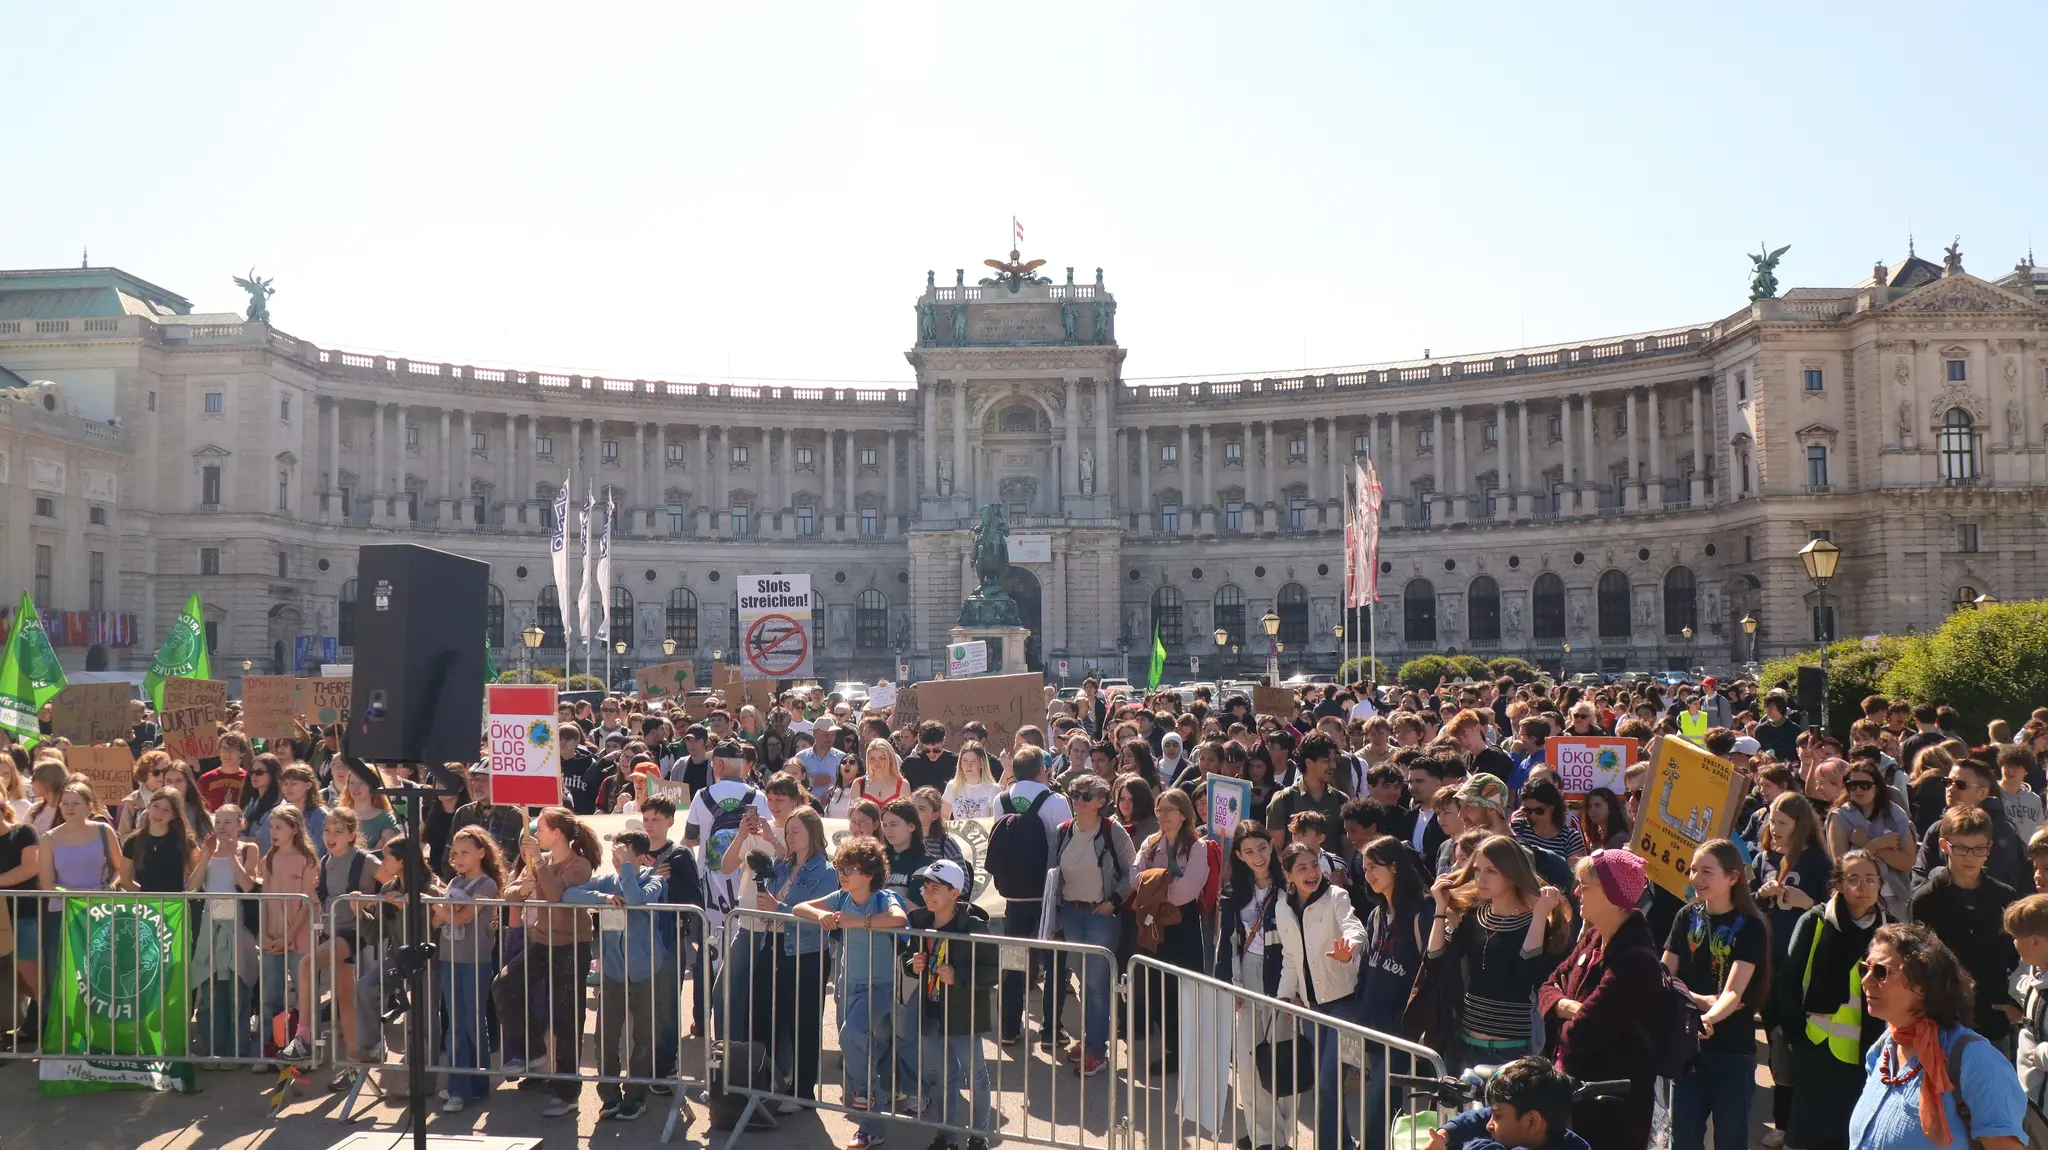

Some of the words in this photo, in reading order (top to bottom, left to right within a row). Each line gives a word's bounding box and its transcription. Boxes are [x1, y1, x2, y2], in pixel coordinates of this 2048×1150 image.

[758, 580, 791, 593] Slots
[741, 594, 808, 608] streichen!
[313, 681, 351, 695] THERE
[168, 692, 185, 704] DIE
[314, 695, 326, 707] IS
[330, 696, 349, 709] NO
[943, 704, 955, 717] A
[960, 704, 1001, 716] BETTER
[160, 710, 186, 732] OUR
[188, 705, 213, 726] TIME
[183, 728, 195, 739] IS
[491, 720, 525, 740] ÖKO
[167, 737, 214, 761] NOW
[492, 741, 525, 756] LOG
[1562, 748, 1594, 764] ÖKO
[492, 757, 527, 772] BRG
[1563, 765, 1593, 777] LOG
[1712, 769, 1729, 781] APRIL
[1563, 778, 1593, 791] BRG
[1216, 794, 1228, 807] ÖKO
[1216, 805, 1227, 816] LOG
[1215, 815, 1227, 826] BRG
[1641, 833, 1657, 857] ÖL
[1661, 849, 1671, 865] &
